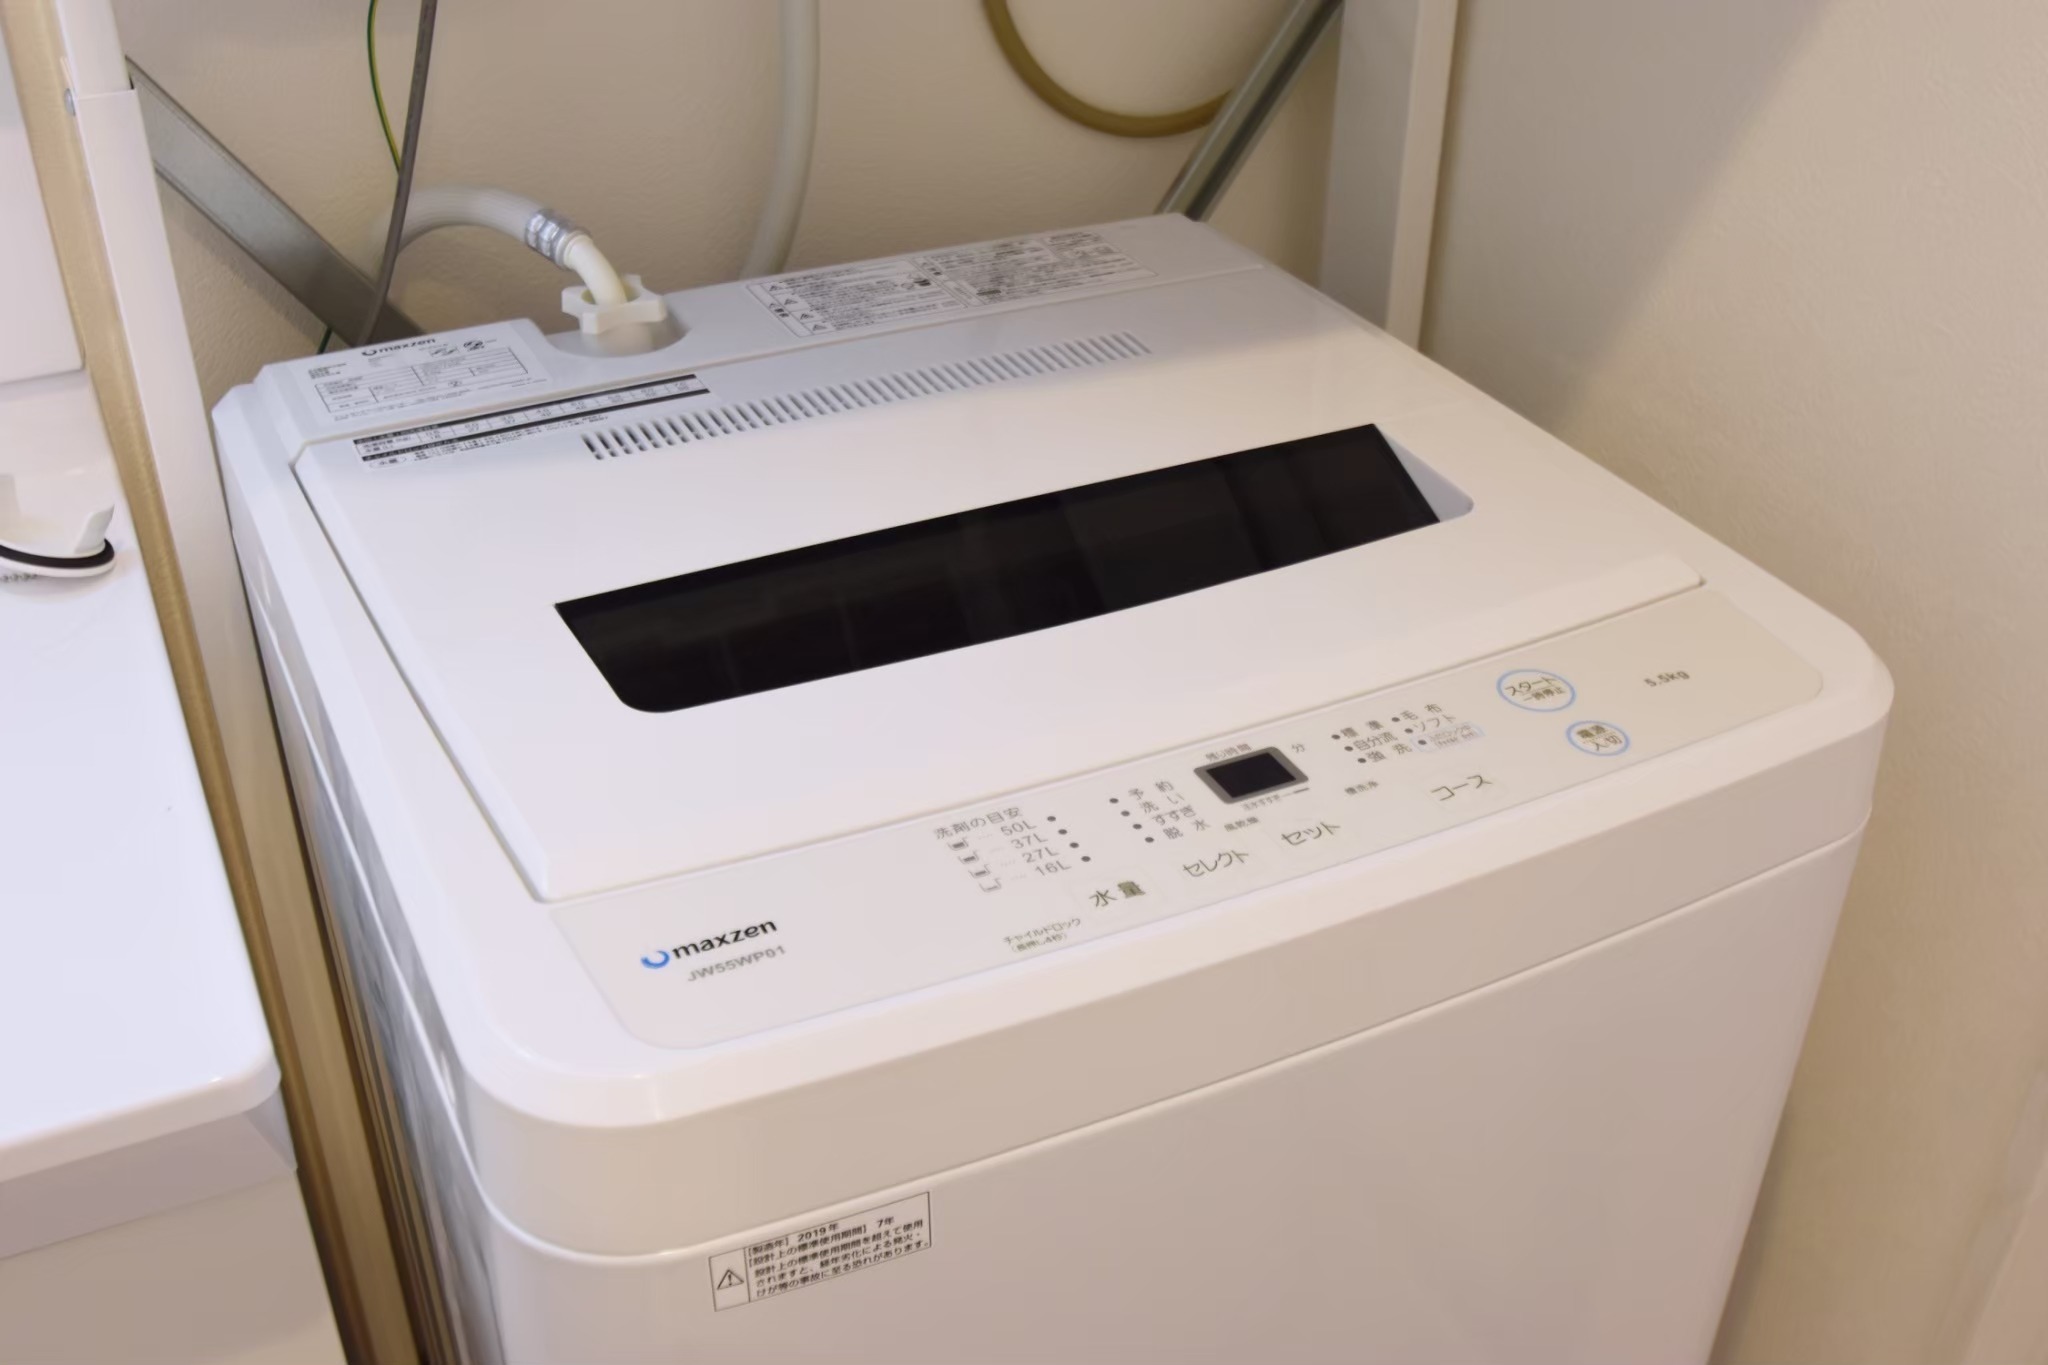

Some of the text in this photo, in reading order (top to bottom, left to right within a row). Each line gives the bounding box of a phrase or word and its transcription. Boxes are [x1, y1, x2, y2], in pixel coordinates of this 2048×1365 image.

[1505, 676, 1558, 696] スタート
[1643, 670, 1690, 687] 5.5kg
[1431, 774, 1493, 801] コース
[934, 807, 1022, 839] 洗剤の目安
[1152, 804, 1197, 826] すすぎ
[1000, 820, 1037, 836] 50L
[1281, 821, 1341, 846] セット
[1010, 833, 1048, 849] 37L
[1022, 846, 1060, 863] 27L
[1182, 849, 1249, 877] セレクト
[1035, 860, 1072, 876] 16L
[672, 920, 777, 959] maxzen
[1003, 918, 1081, 945] チャイルドロック
[687, 945, 786, 982] JW55WP01
